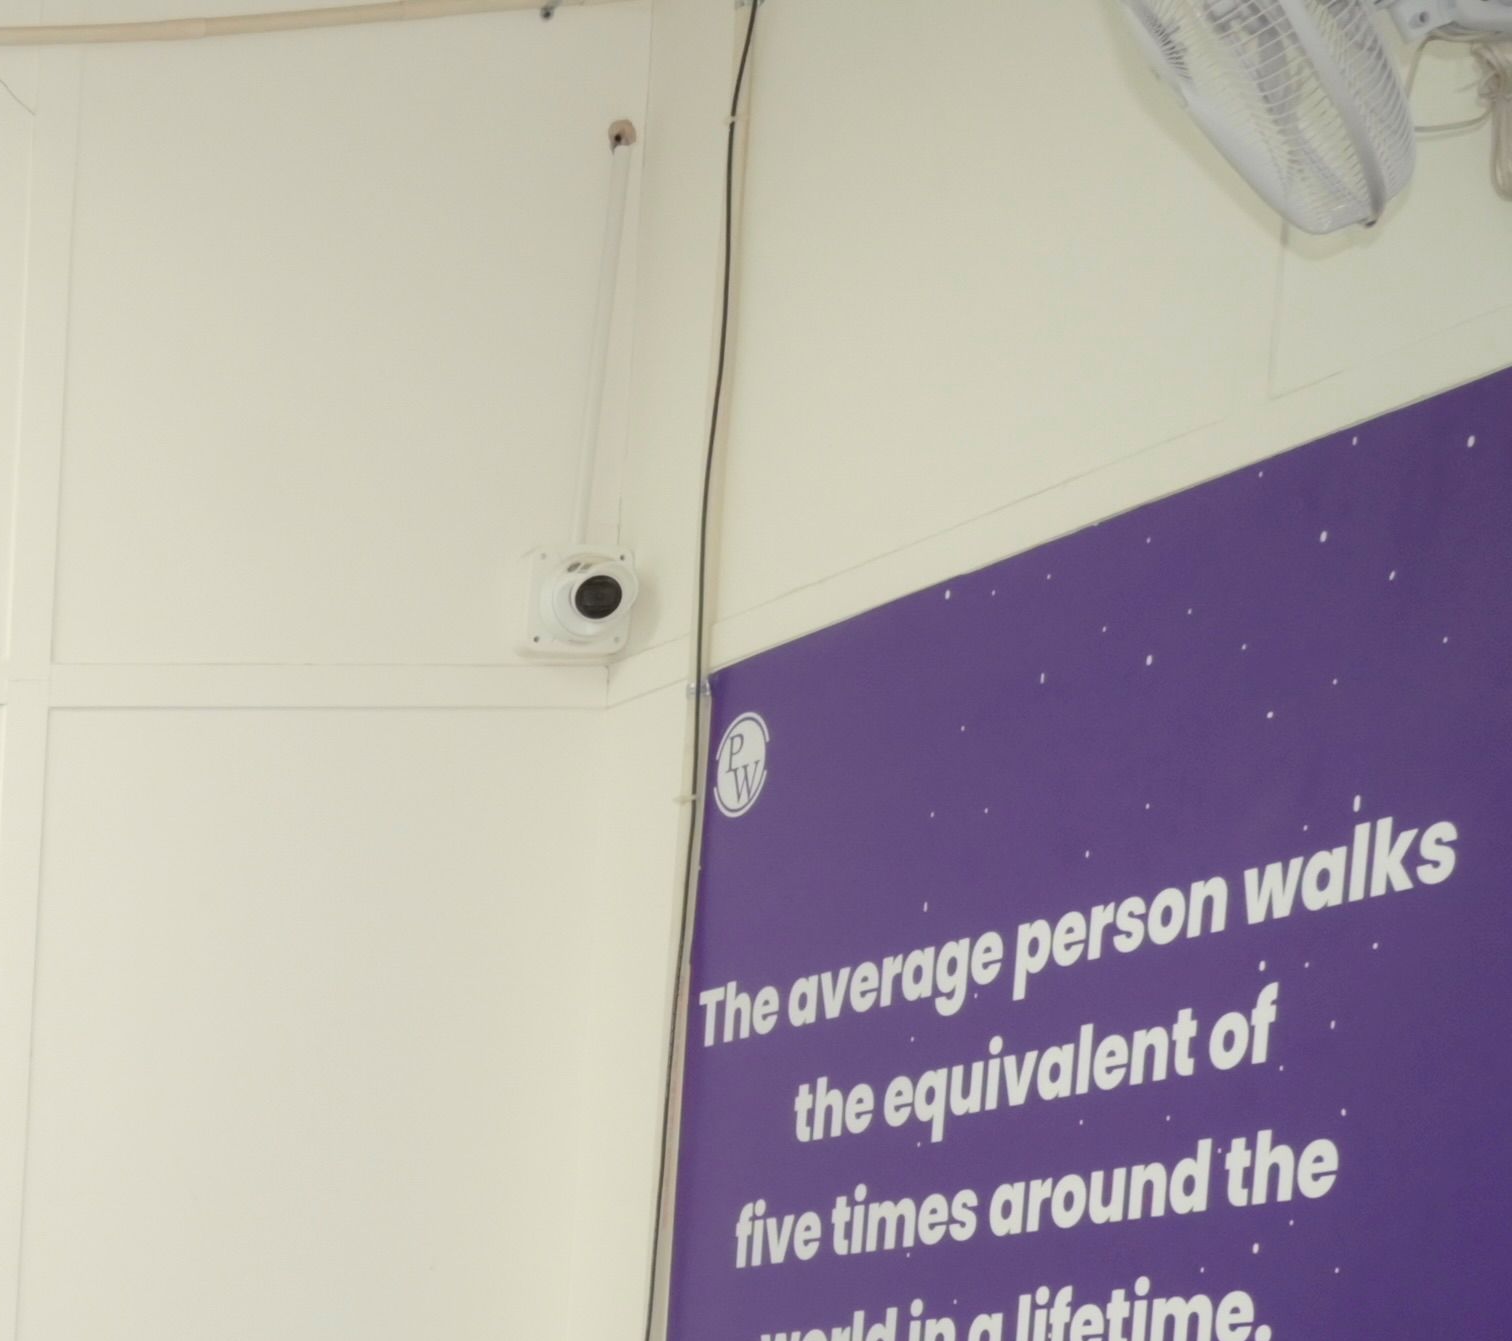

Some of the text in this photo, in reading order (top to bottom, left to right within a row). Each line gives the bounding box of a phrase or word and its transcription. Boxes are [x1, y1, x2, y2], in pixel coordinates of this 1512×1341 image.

[699, 814, 1460, 1047] The average person walks
[793, 981, 1280, 1142] the equivalent of
[734, 1127, 1341, 1269] five times around the
